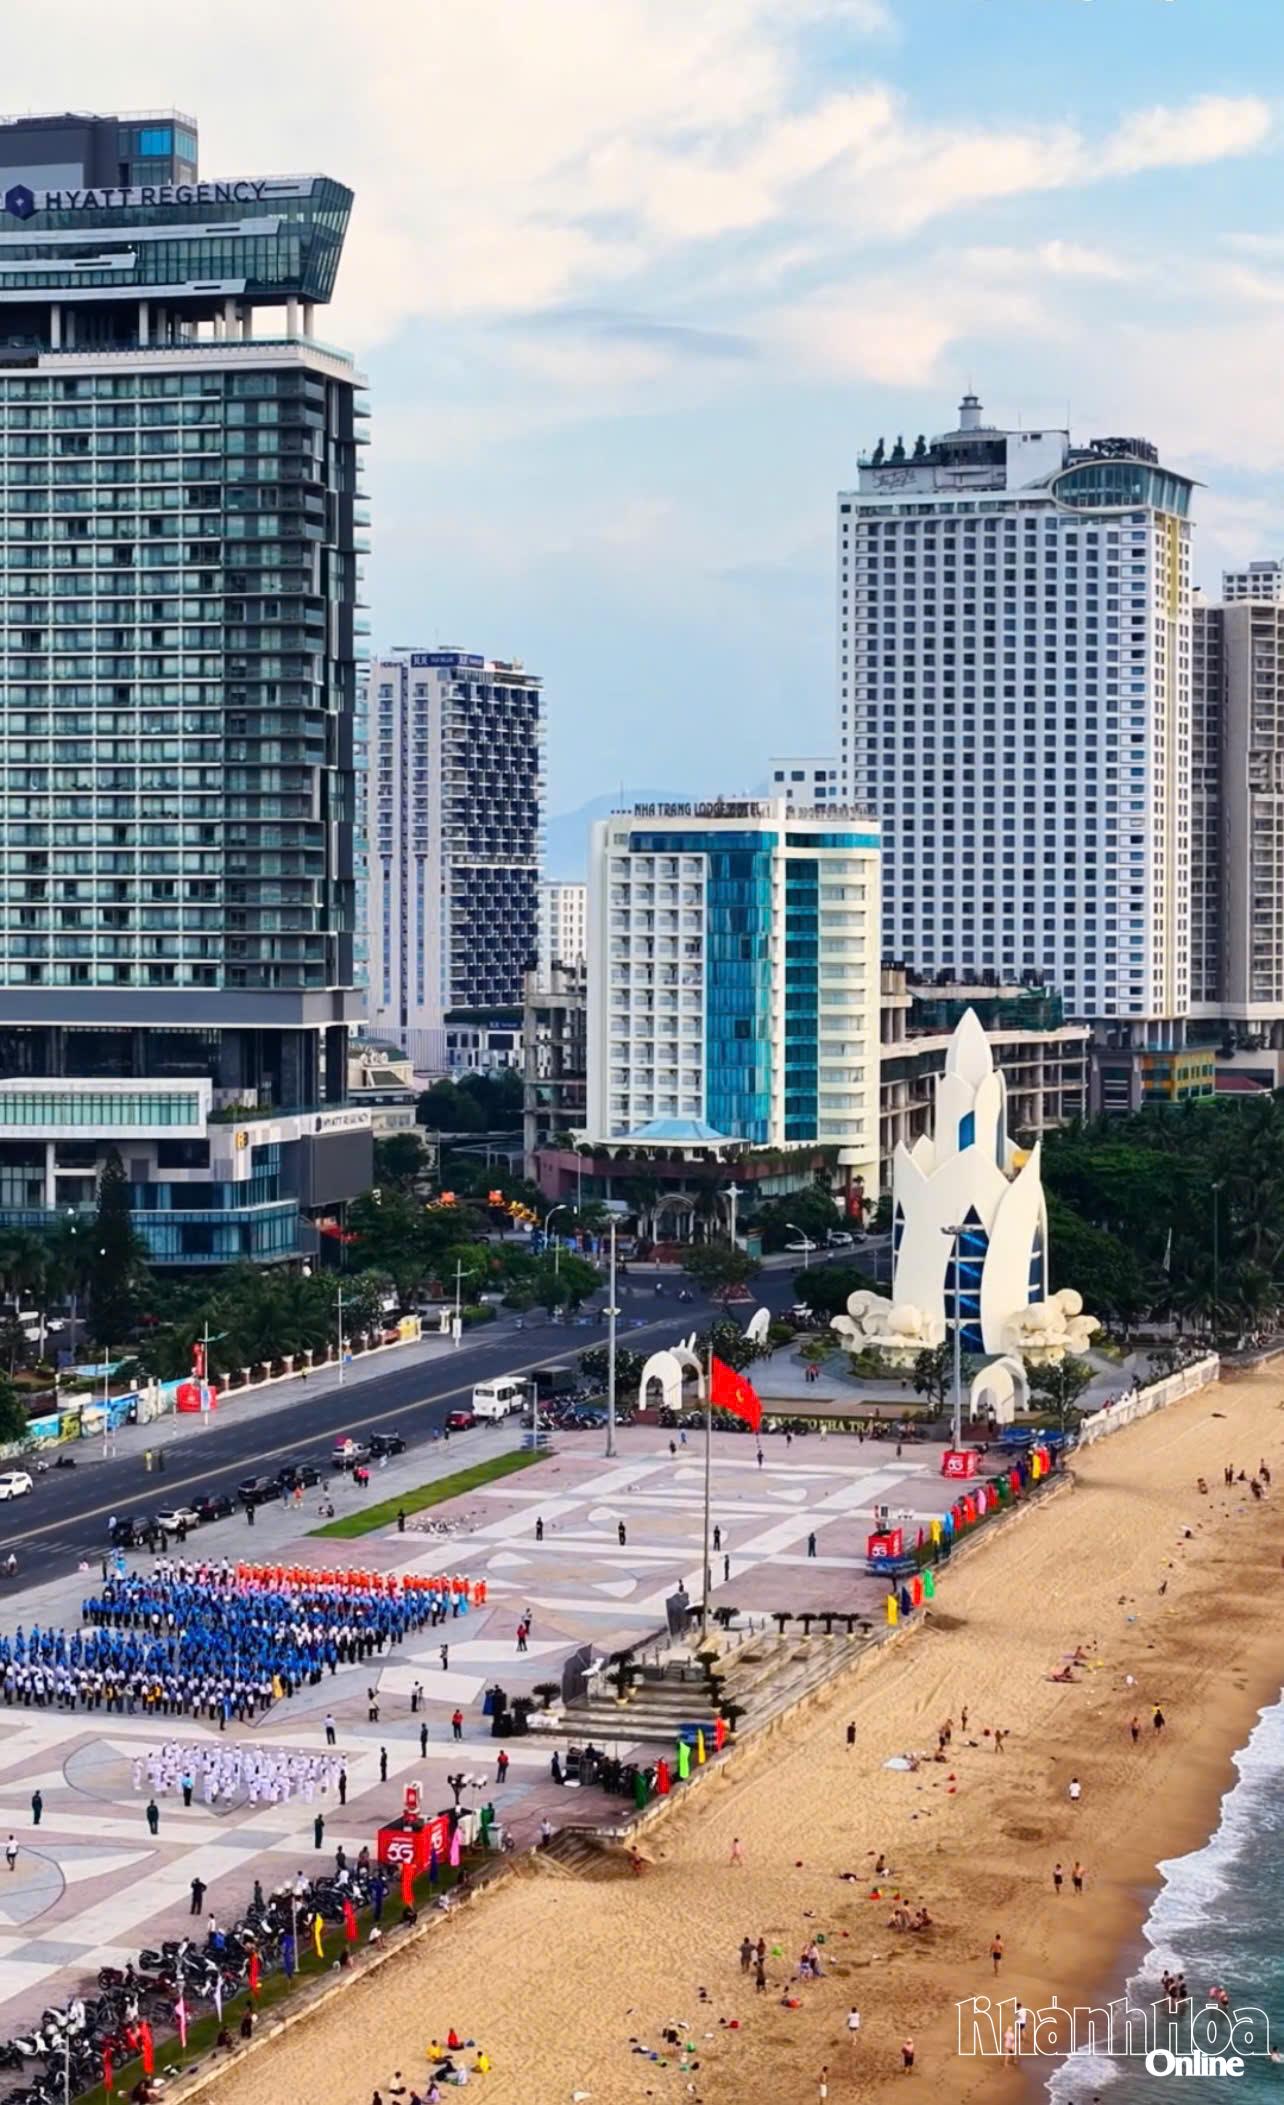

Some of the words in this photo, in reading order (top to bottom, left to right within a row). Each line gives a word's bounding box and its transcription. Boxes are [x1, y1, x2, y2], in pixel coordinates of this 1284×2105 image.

[45, 188, 132, 211] HYATT
[141, 181, 266, 207] REGENCY
[634, 802, 656, 816] NHA
[658, 802, 692, 816] TRANG
[387, 1842, 414, 1864] 5G
